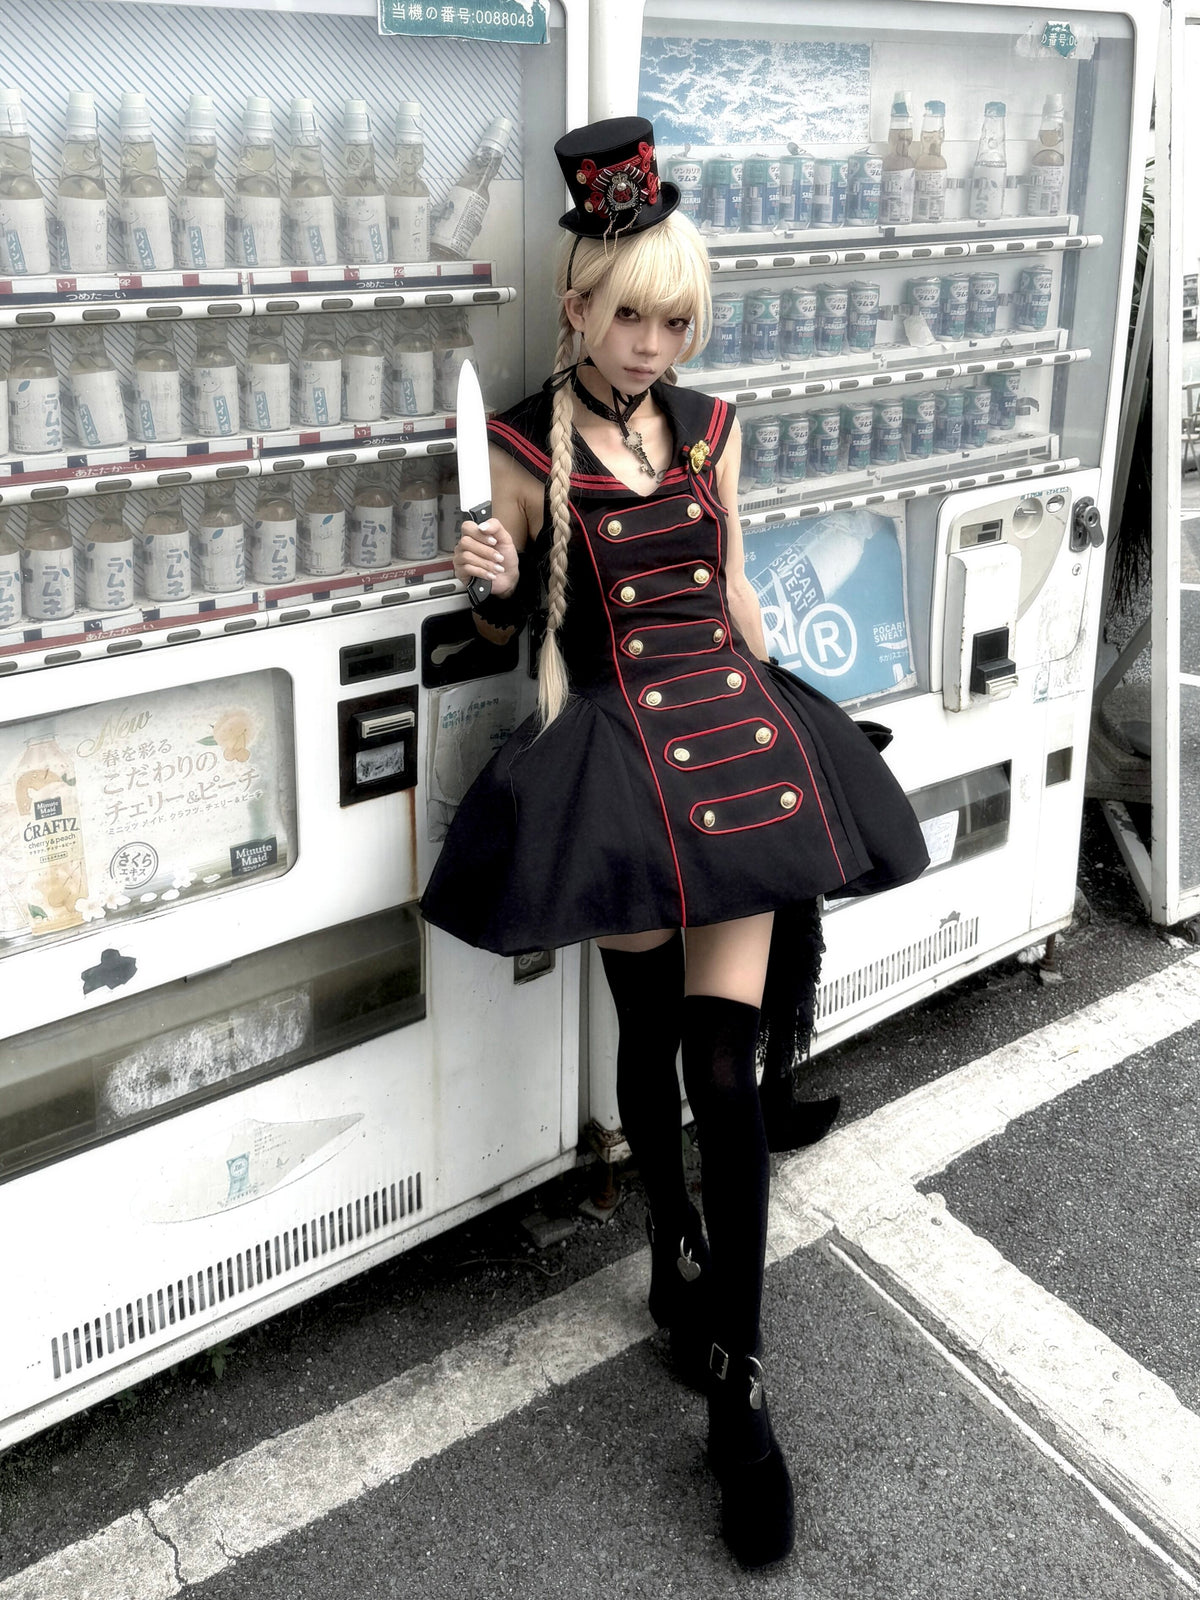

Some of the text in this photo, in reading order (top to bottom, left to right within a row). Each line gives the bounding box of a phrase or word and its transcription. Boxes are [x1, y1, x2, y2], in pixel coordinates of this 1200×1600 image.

[392, 3, 534, 27] 当機の番号:0088048
[677, 175, 698, 183] ラムネ
[43, 393, 62, 446] ラムネ
[361, 520, 378, 564] ラムネ
[420, 512, 435, 556] ラムネ
[166, 548, 185, 597] ラムネ
[272, 534, 289, 580] ラムネ
[784, 547, 818, 608] POCARI
[42, 565, 62, 615] ラムネ
[107, 557, 126, 605] ラムネ
[772, 556, 810, 612] SWEAT
[873, 621, 906, 636] POCARI
[874, 629, 904, 643] SWEAT
[77, 707, 153, 758] New
[102, 738, 172, 768] 春を彩る
[103, 751, 218, 795] こだわりの
[104, 767, 260, 826] チェリー&ピーチ
[118, 851, 153, 869] さくら
[119, 866, 147, 877] エキス
[236, 843, 274, 860] Minute
[241, 853, 268, 867] Maid
